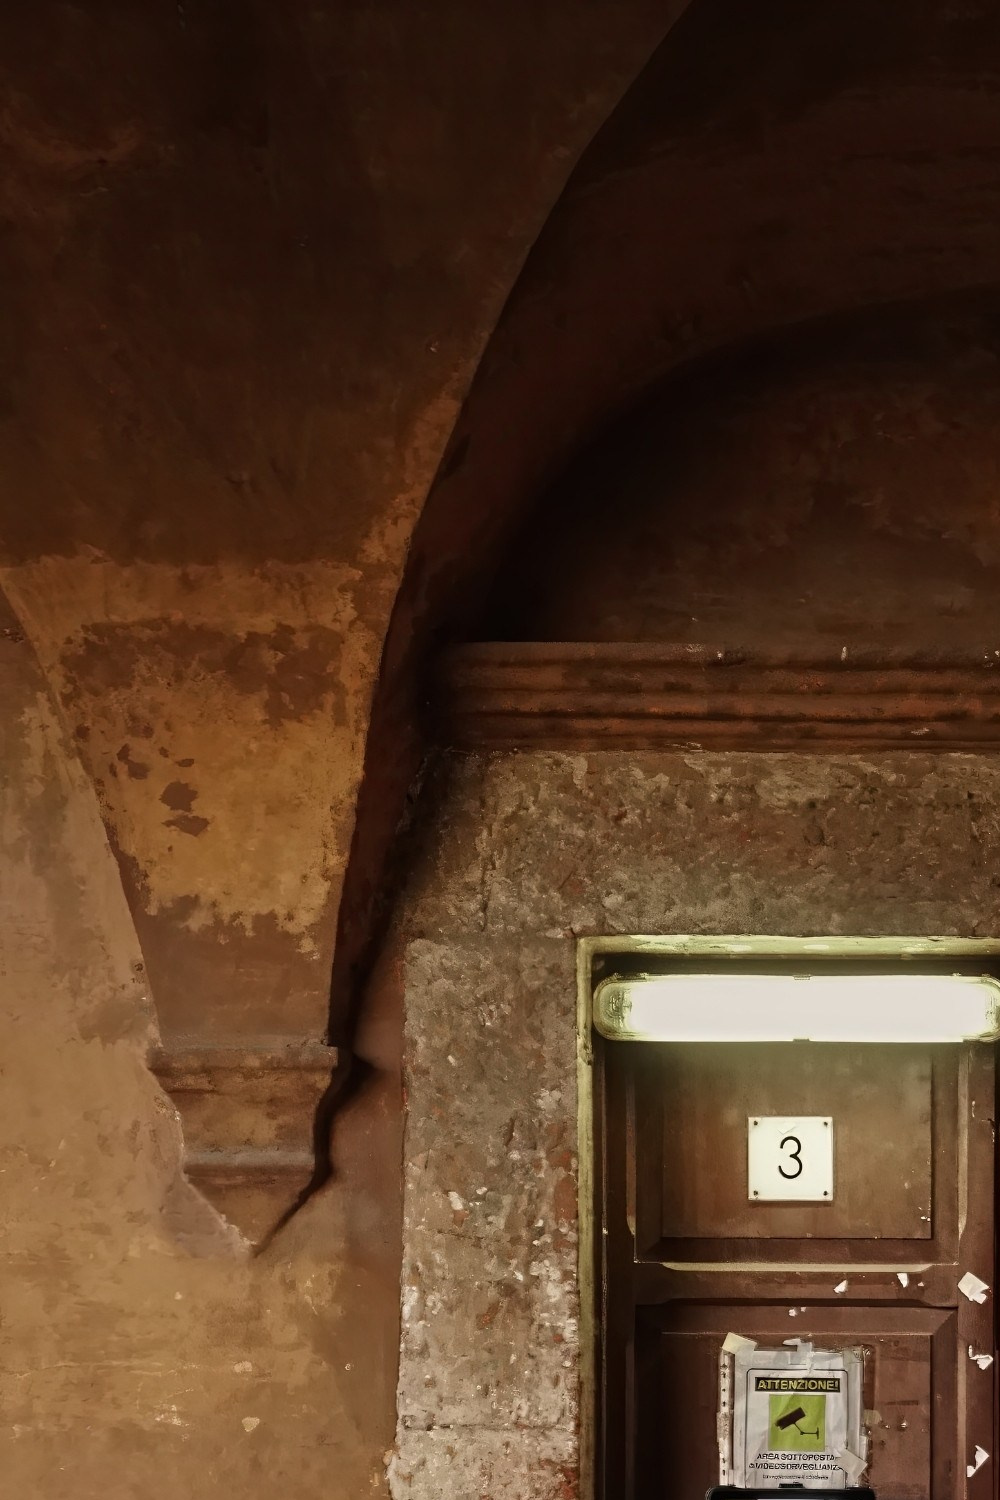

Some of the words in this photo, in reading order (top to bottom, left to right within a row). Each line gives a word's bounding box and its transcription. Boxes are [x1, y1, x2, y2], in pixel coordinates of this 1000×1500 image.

[778, 1135, 803, 1179] 3
[757, 1379, 839, 1391] ATTENZIONE!
[756, 1452, 780, 1460] AREA
[780, 1453, 835, 1462] SOTTOPOSTA
[755, 1462, 839, 1471] VIDEOSORVEGLIANZ
